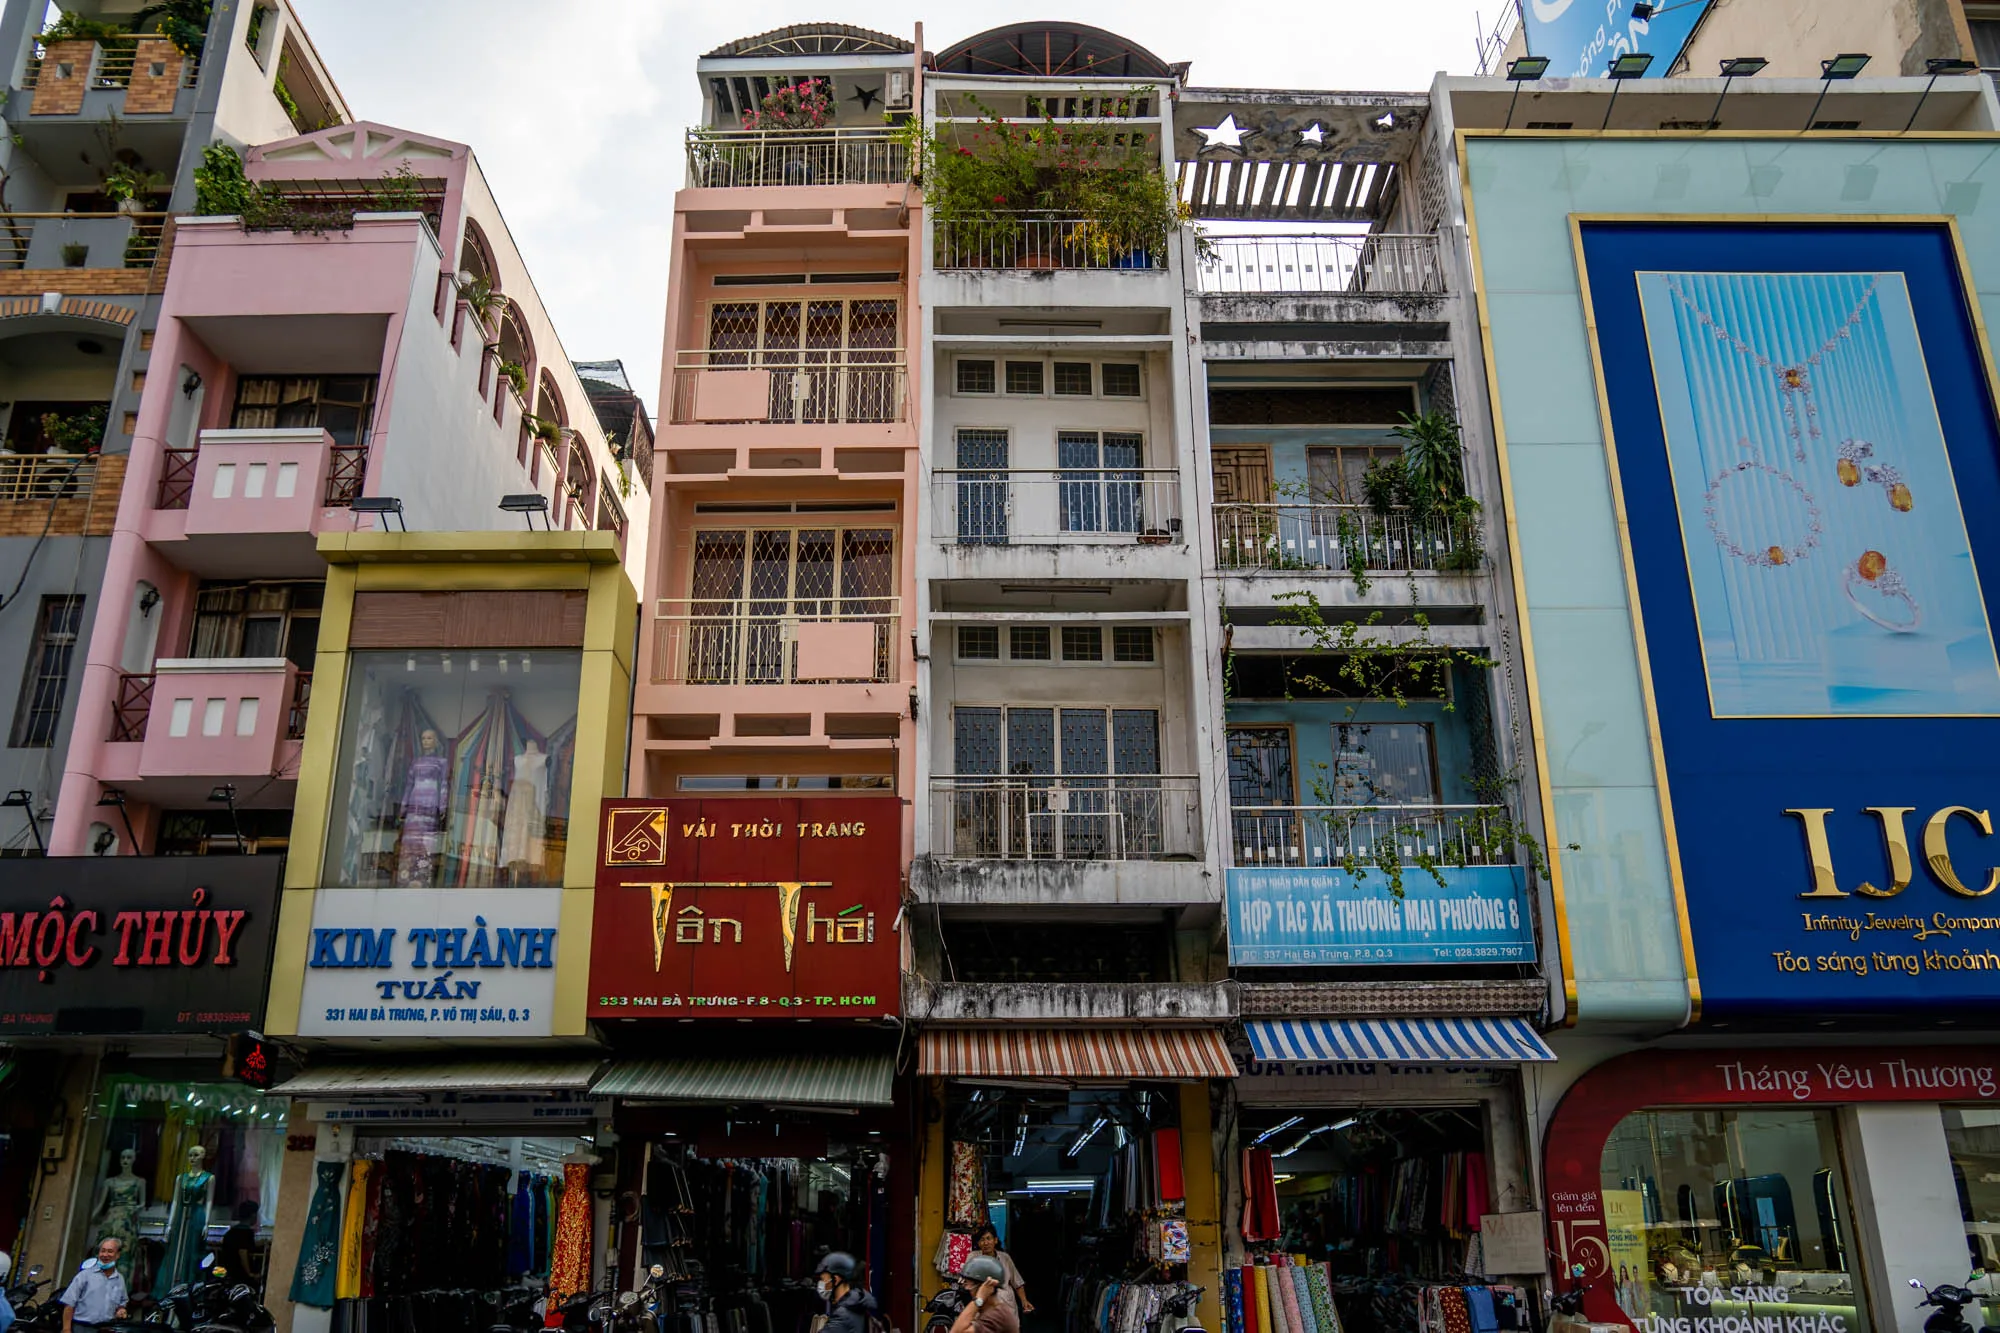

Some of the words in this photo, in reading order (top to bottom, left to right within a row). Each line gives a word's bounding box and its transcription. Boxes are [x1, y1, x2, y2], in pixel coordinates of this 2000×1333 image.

[682, 818, 717, 838] VẢI
[731, 818, 782, 838] THỜI
[797, 822, 866, 838] TRANG
[1783, 806, 2000, 897] IJC
[1334, 877, 1341, 887] 3
[620, 882, 742, 972] Tân
[745, 882, 875, 972] Thái
[1239, 897, 1272, 940] HỢP
[1276, 893, 1307, 932] TÁC
[1311, 894, 1334, 932] XÃ
[1336, 897, 1400, 932] THƯƠNG
[1405, 899, 1437, 938] MẠI
[1440, 890, 1504, 931] PHƯỜNG
[1508, 897, 1520, 930] 8
[1801, 913, 1863, 940] Infinity
[1864, 913, 1935, 940] Jewelry
[1932, 912, 2000, 932] Compan
[0, 895, 97, 982] MỘC
[112, 888, 245, 966] THỦY
[309, 928, 396, 968] KIM
[408, 915, 556, 968] THÀNH
[1264, 950, 1281, 960] 337
[1284, 950, 1300, 961] Hai
[1376, 948, 1393, 959] Q.3
[1433, 948, 1453, 959] Tel:
[1773, 950, 1811, 972] Tỏa
[1816, 952, 1867, 975] sáng
[1924, 949, 2000, 971] khoảnh
[376, 971, 481, 999] TUẤN
[600, 996, 628, 1006] 333
[633, 996, 658, 1006] HAI
[662, 993, 682, 1006] BÀ
[839, 996, 876, 1006] HCM
[326, 1008, 345, 1021] 331
[348, 1008, 368, 1021] HAI
[370, 1005, 385, 1021] BÀ
[388, 1007, 427, 1023] TRƯNG,
[430, 1008, 440, 1021] P.
[443, 1006, 457, 1021] VÕ
[460, 1008, 477, 1024] THỊ
[480, 1005, 506, 1023] SÁU,
[508, 1008, 519, 1022] Q.
[522, 1008, 530, 1021] 3
[1715, 1061, 1811, 1099] Tháng
[1817, 1063, 1873, 1089] Yêu
[1880, 1059, 1997, 1096] Thương
[1557, 1204, 1573, 1213] lên
[1575, 1202, 1595, 1213] đến
[1582, 1191, 1597, 1205] giá
[1681, 1281, 1727, 1305] TỎA
[1731, 1281, 1789, 1304] SÁNG
[1694, 1310, 1784, 1333] KHOẢNH
[1788, 1309, 1847, 1333] KHẮC
